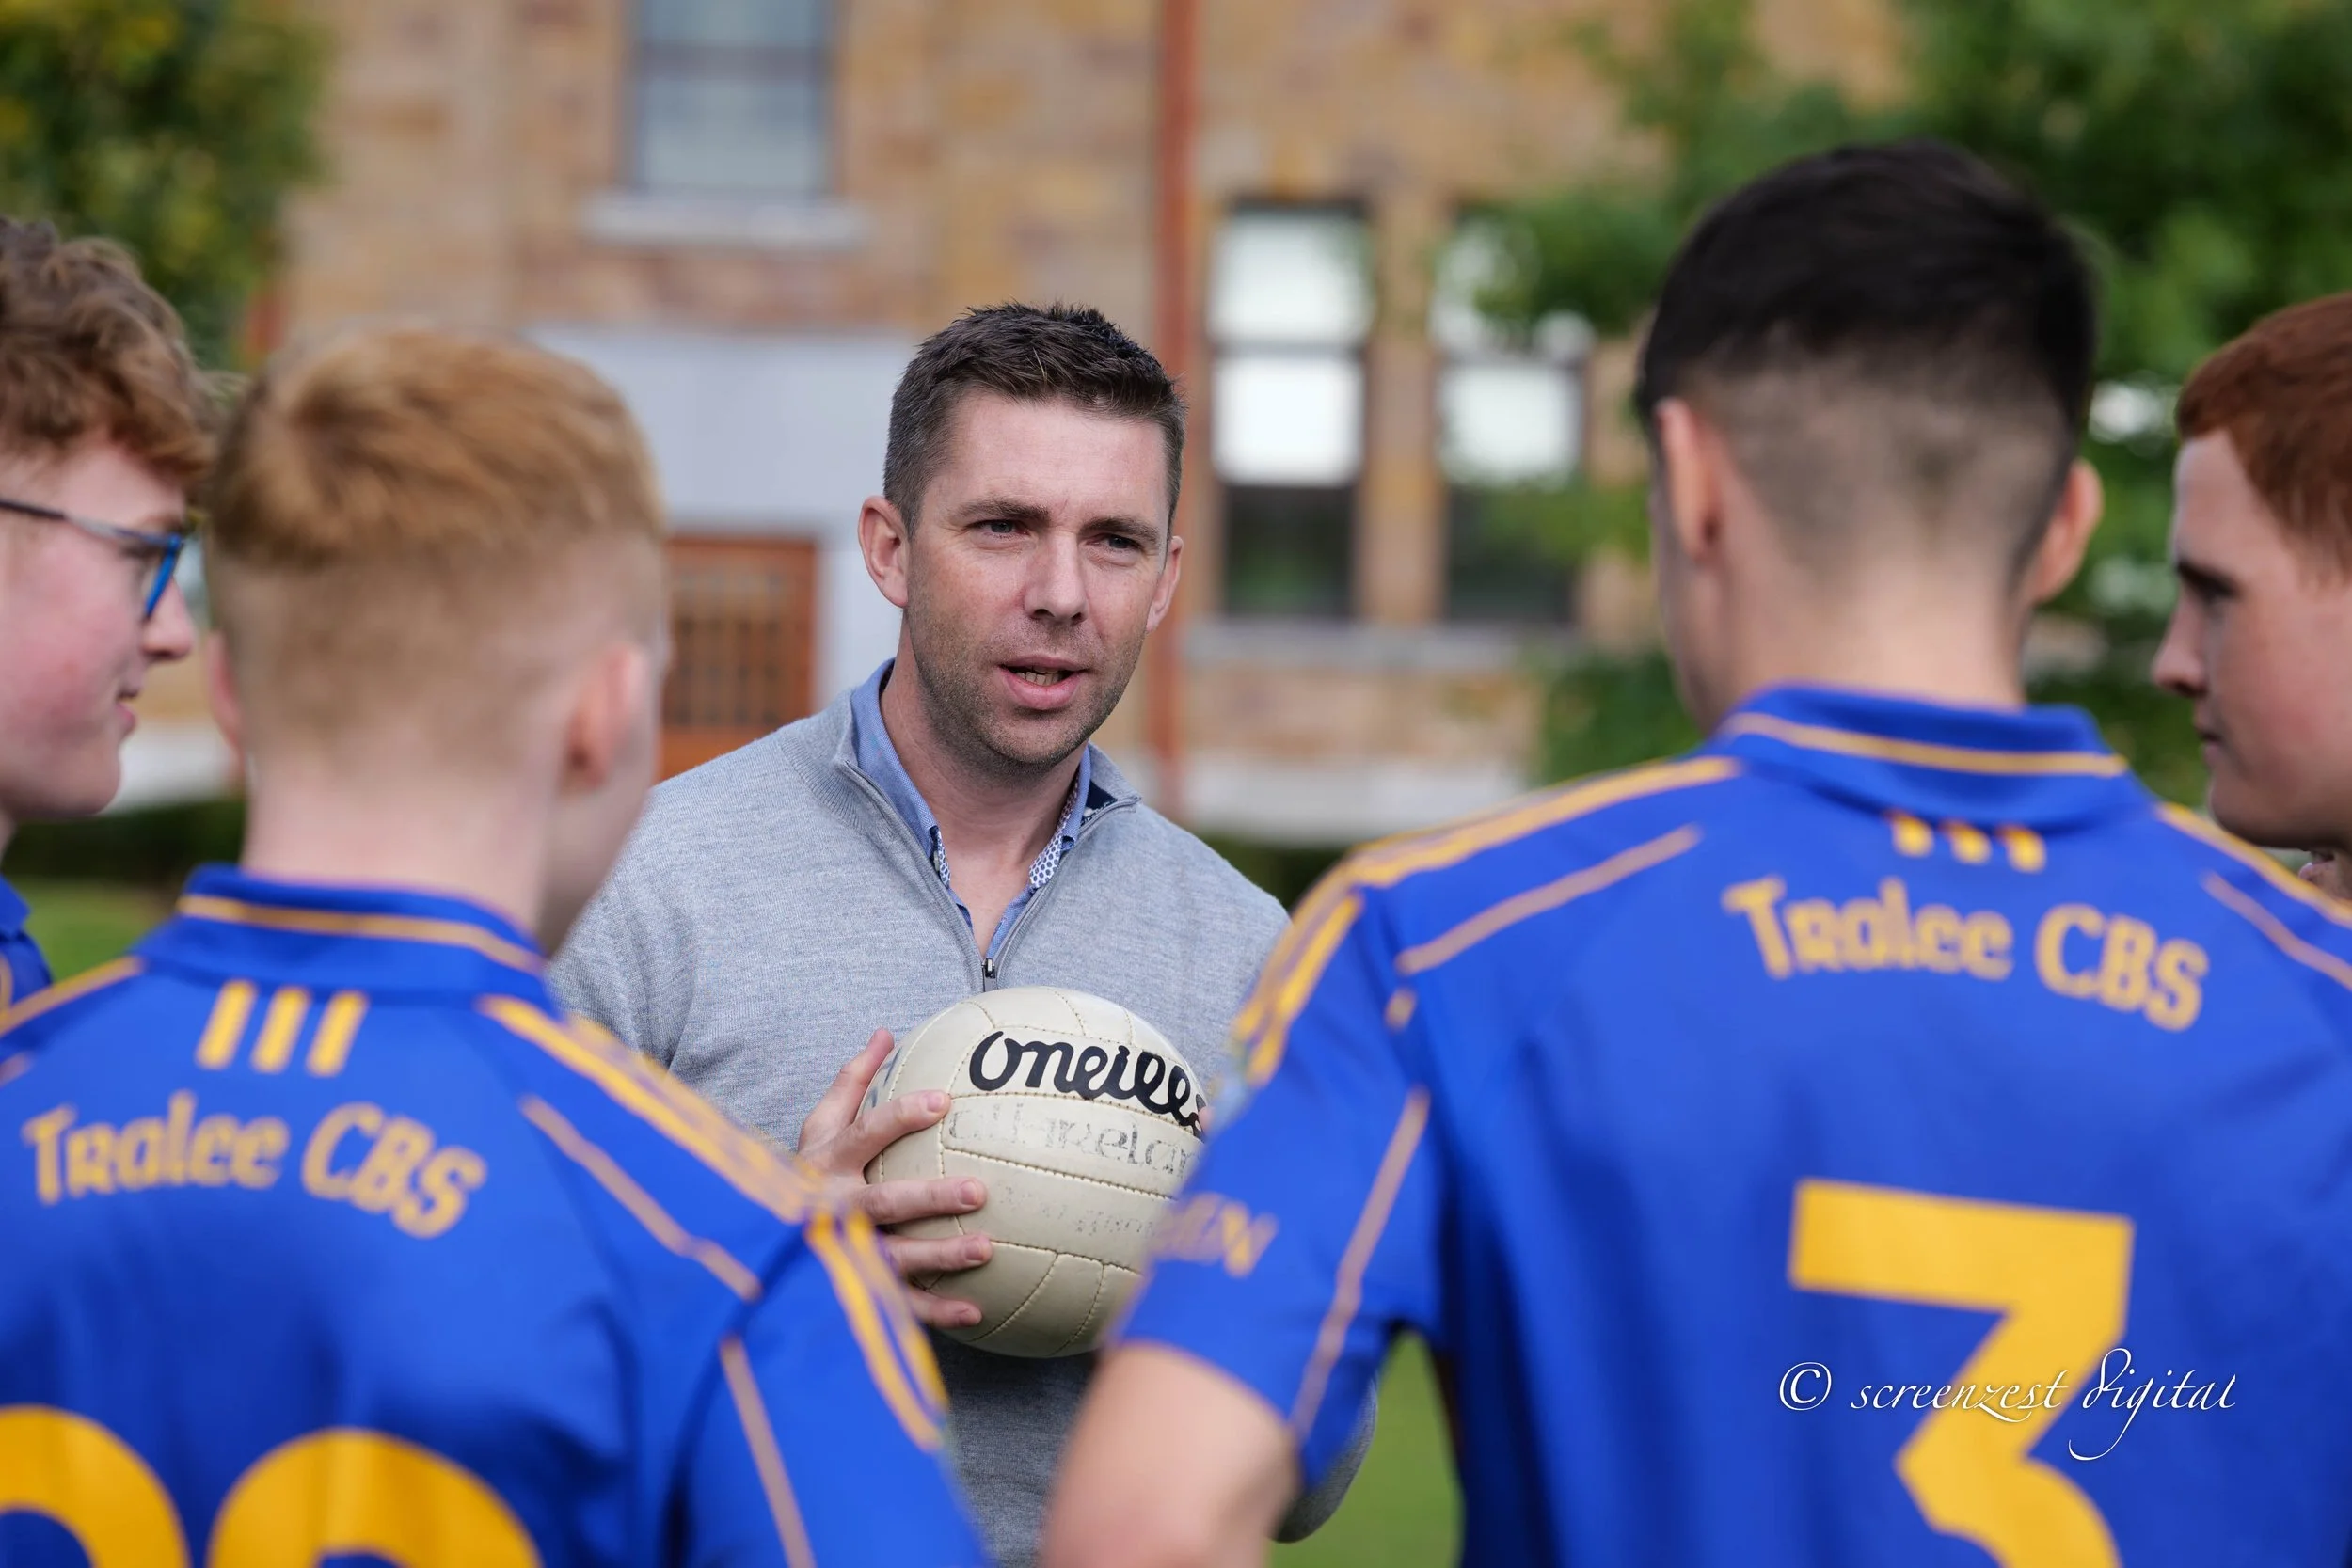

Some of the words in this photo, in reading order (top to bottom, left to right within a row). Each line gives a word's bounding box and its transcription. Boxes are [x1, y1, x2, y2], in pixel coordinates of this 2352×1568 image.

[2034, 902, 2209, 1031] CBS
[301, 1101, 486, 1239] CBS
[1788, 1176, 2136, 1568] 3
